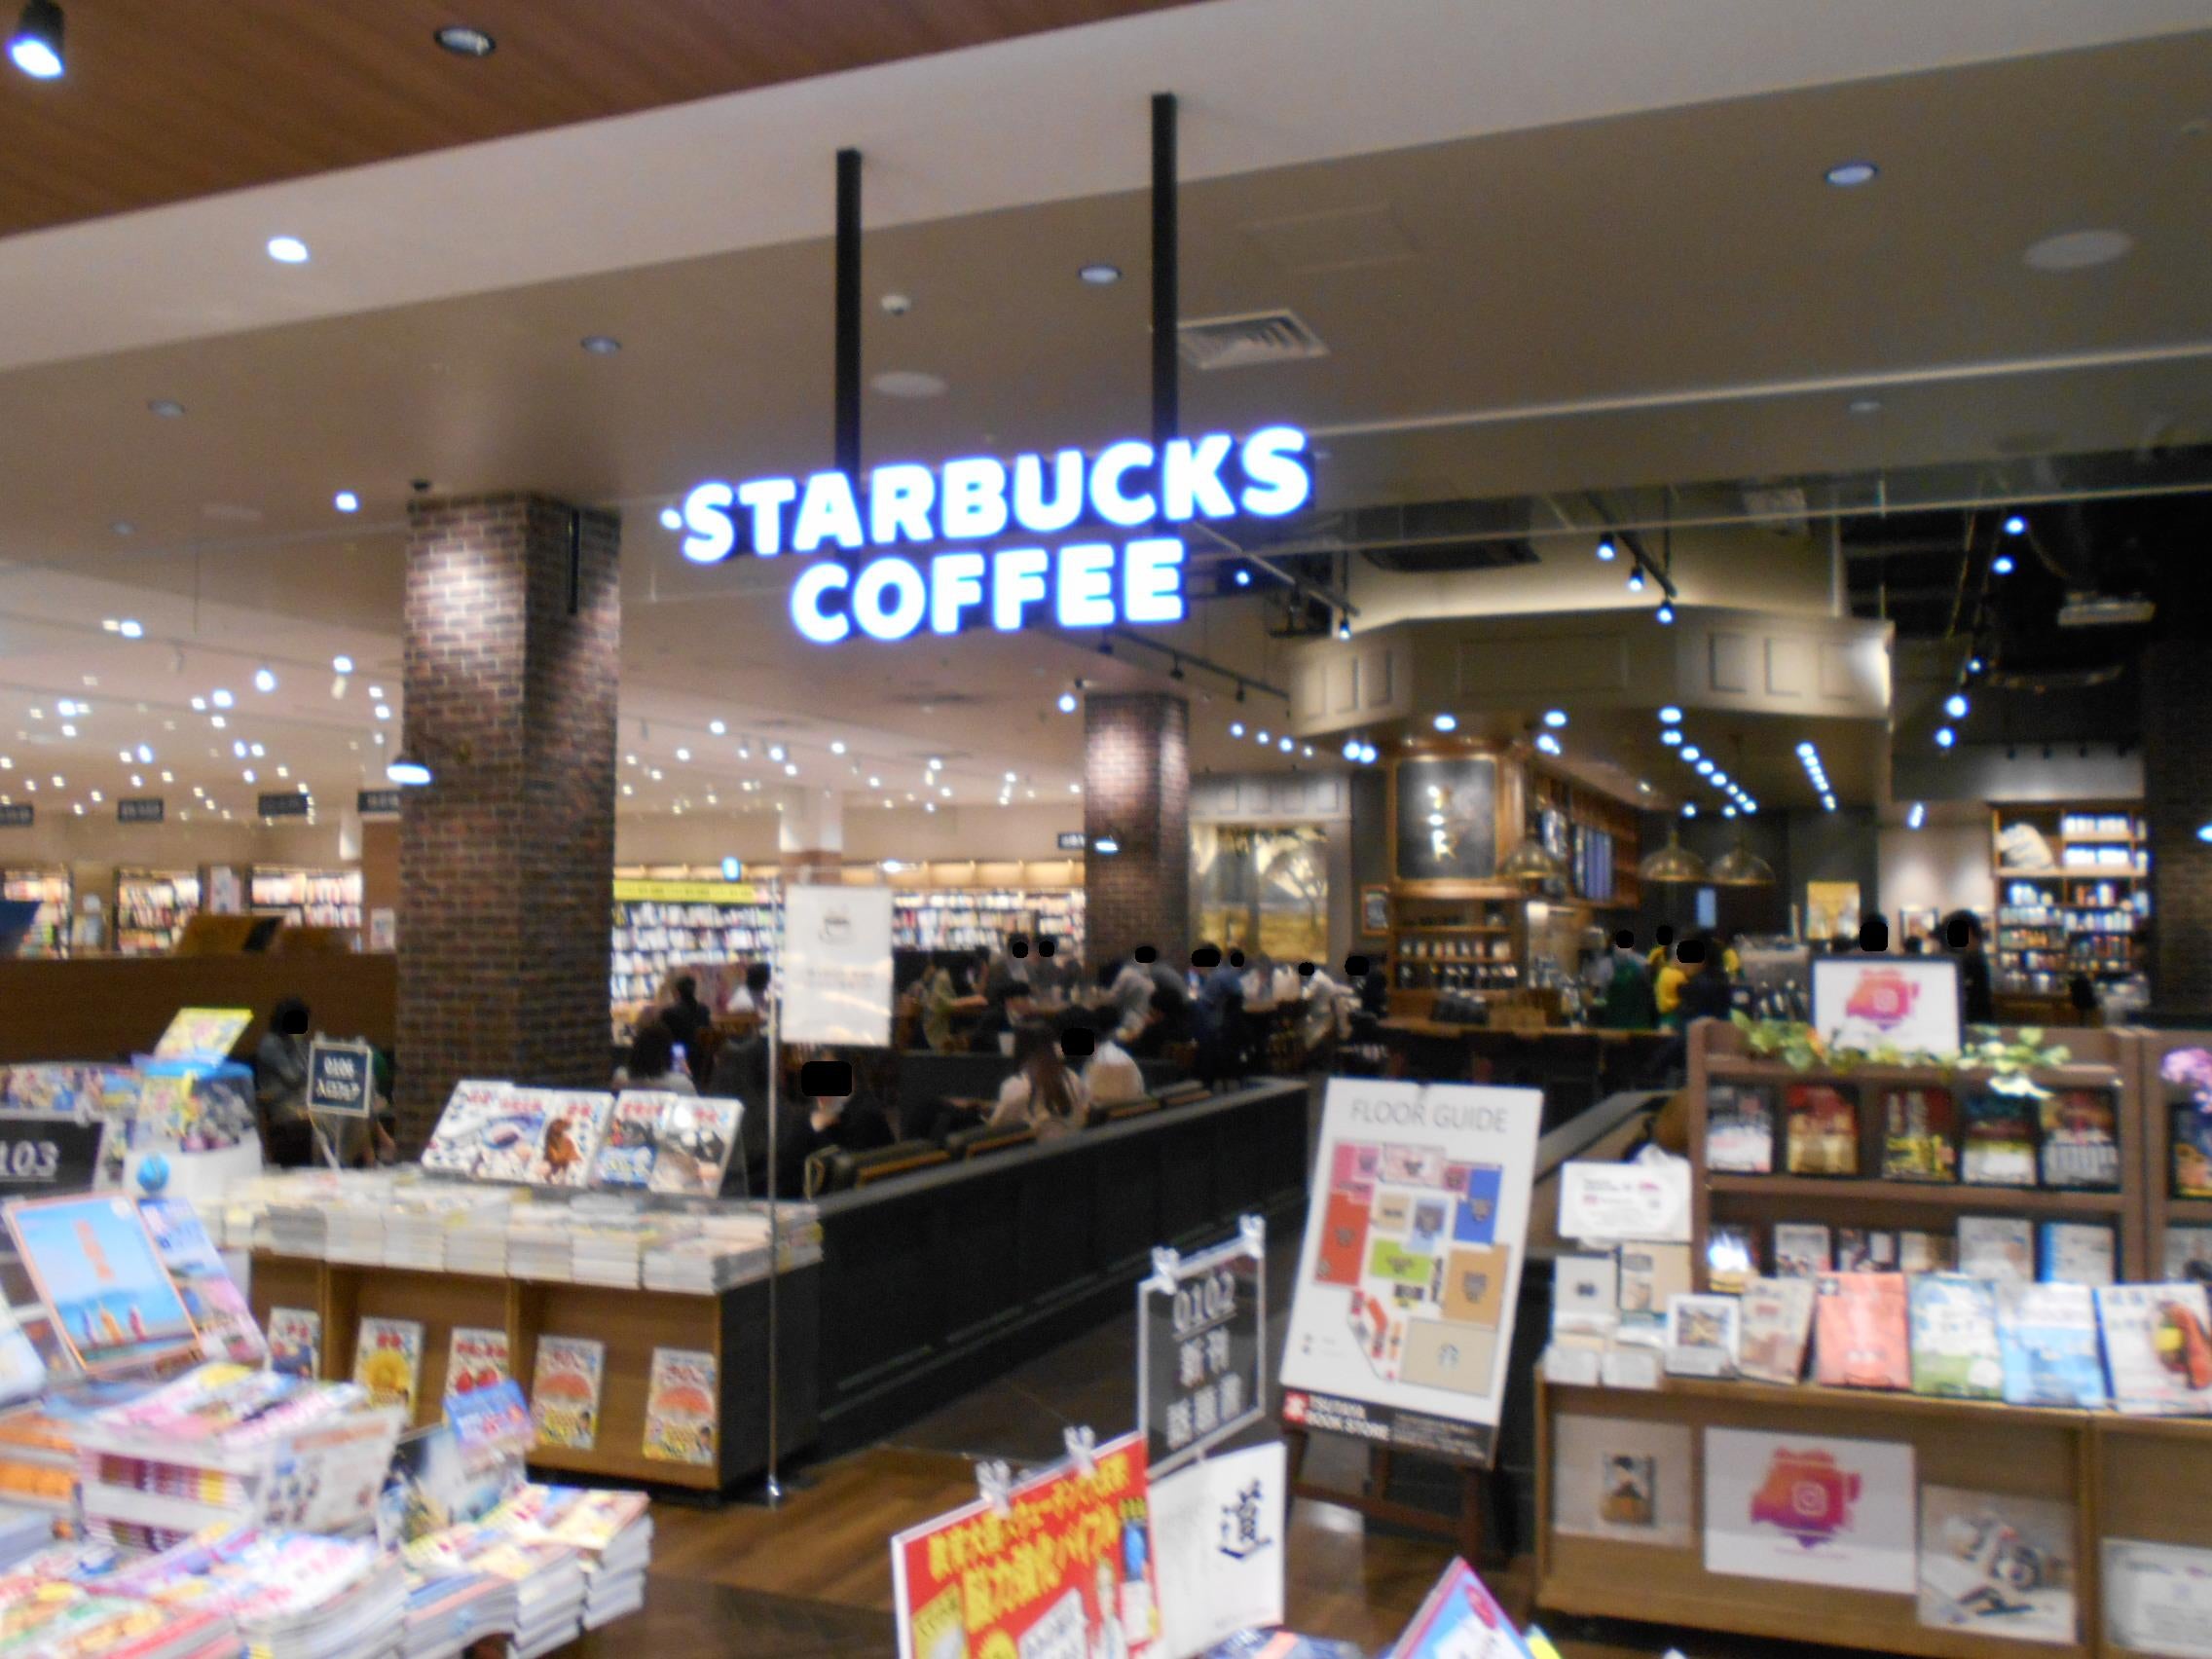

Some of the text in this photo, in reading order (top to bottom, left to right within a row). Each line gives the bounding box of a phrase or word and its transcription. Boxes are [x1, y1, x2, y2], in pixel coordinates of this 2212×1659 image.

[682, 426, 1310, 563] STARBUCKS
[791, 537, 1186, 643] COFFEE
[1349, 1097, 1509, 1133] FLOOR GUIDE
